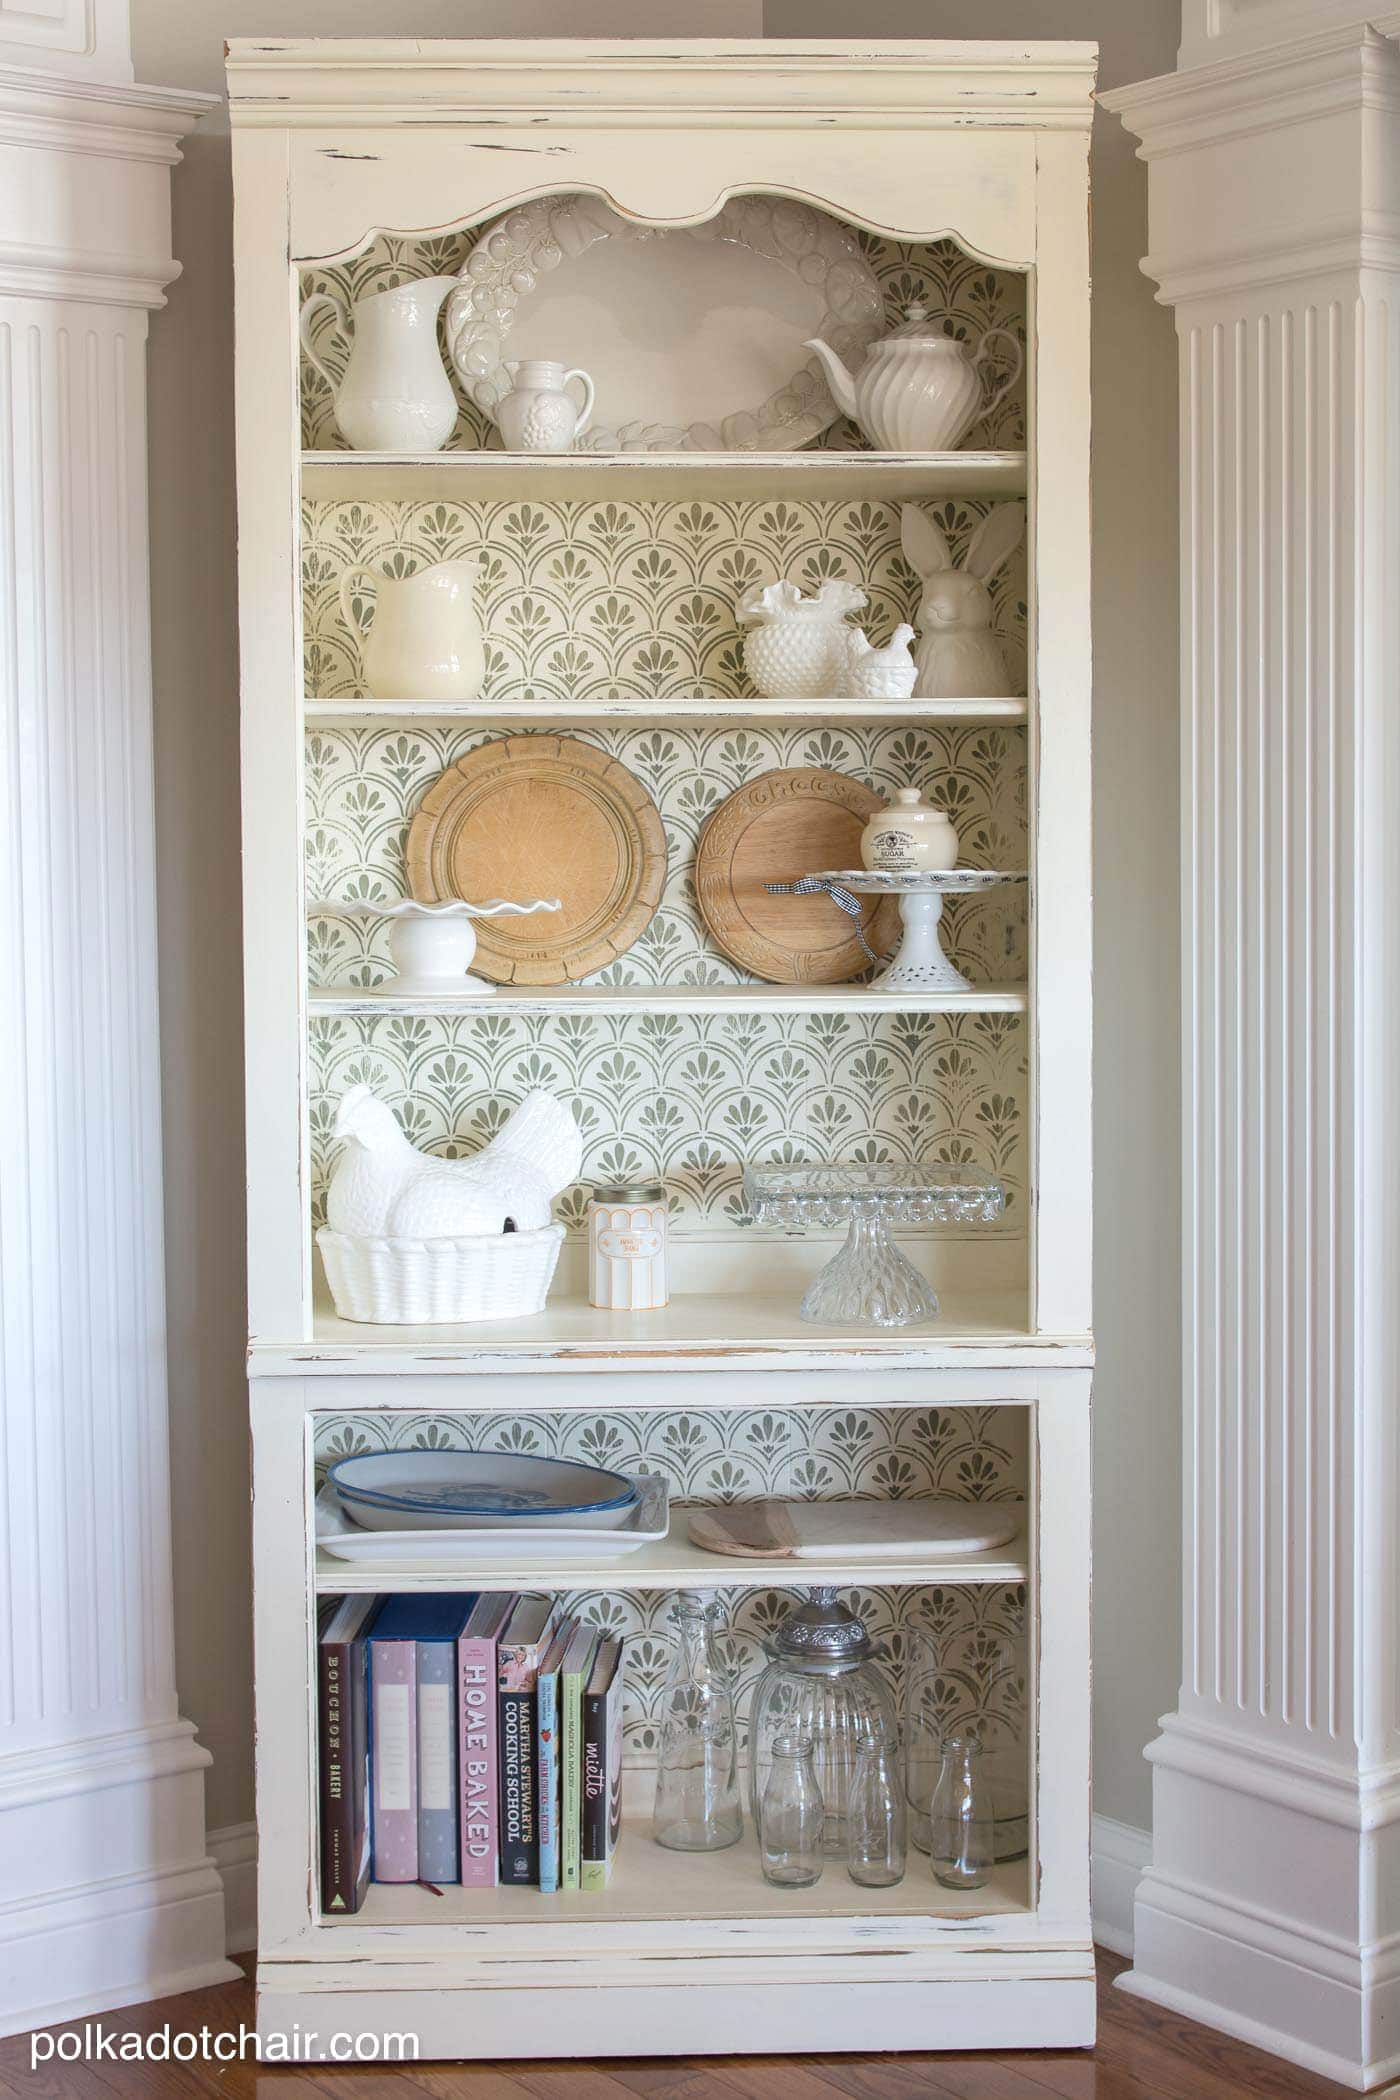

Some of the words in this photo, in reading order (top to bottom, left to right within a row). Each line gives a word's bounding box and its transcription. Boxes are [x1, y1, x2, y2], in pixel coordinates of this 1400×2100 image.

[328, 1656, 340, 1749] BOUCHON
[464, 1664, 488, 1751] HOME
[505, 1701, 518, 1775] COOKING
[519, 1701, 531, 1762] MARTHA
[330, 1764, 341, 1799] BAKERY
[520, 1765, 532, 1843] STEWART'S
[586, 1742, 605, 1799] miette
[466, 1760, 490, 1857] BAKED
[507, 1778, 520, 1842] SCHOOL
